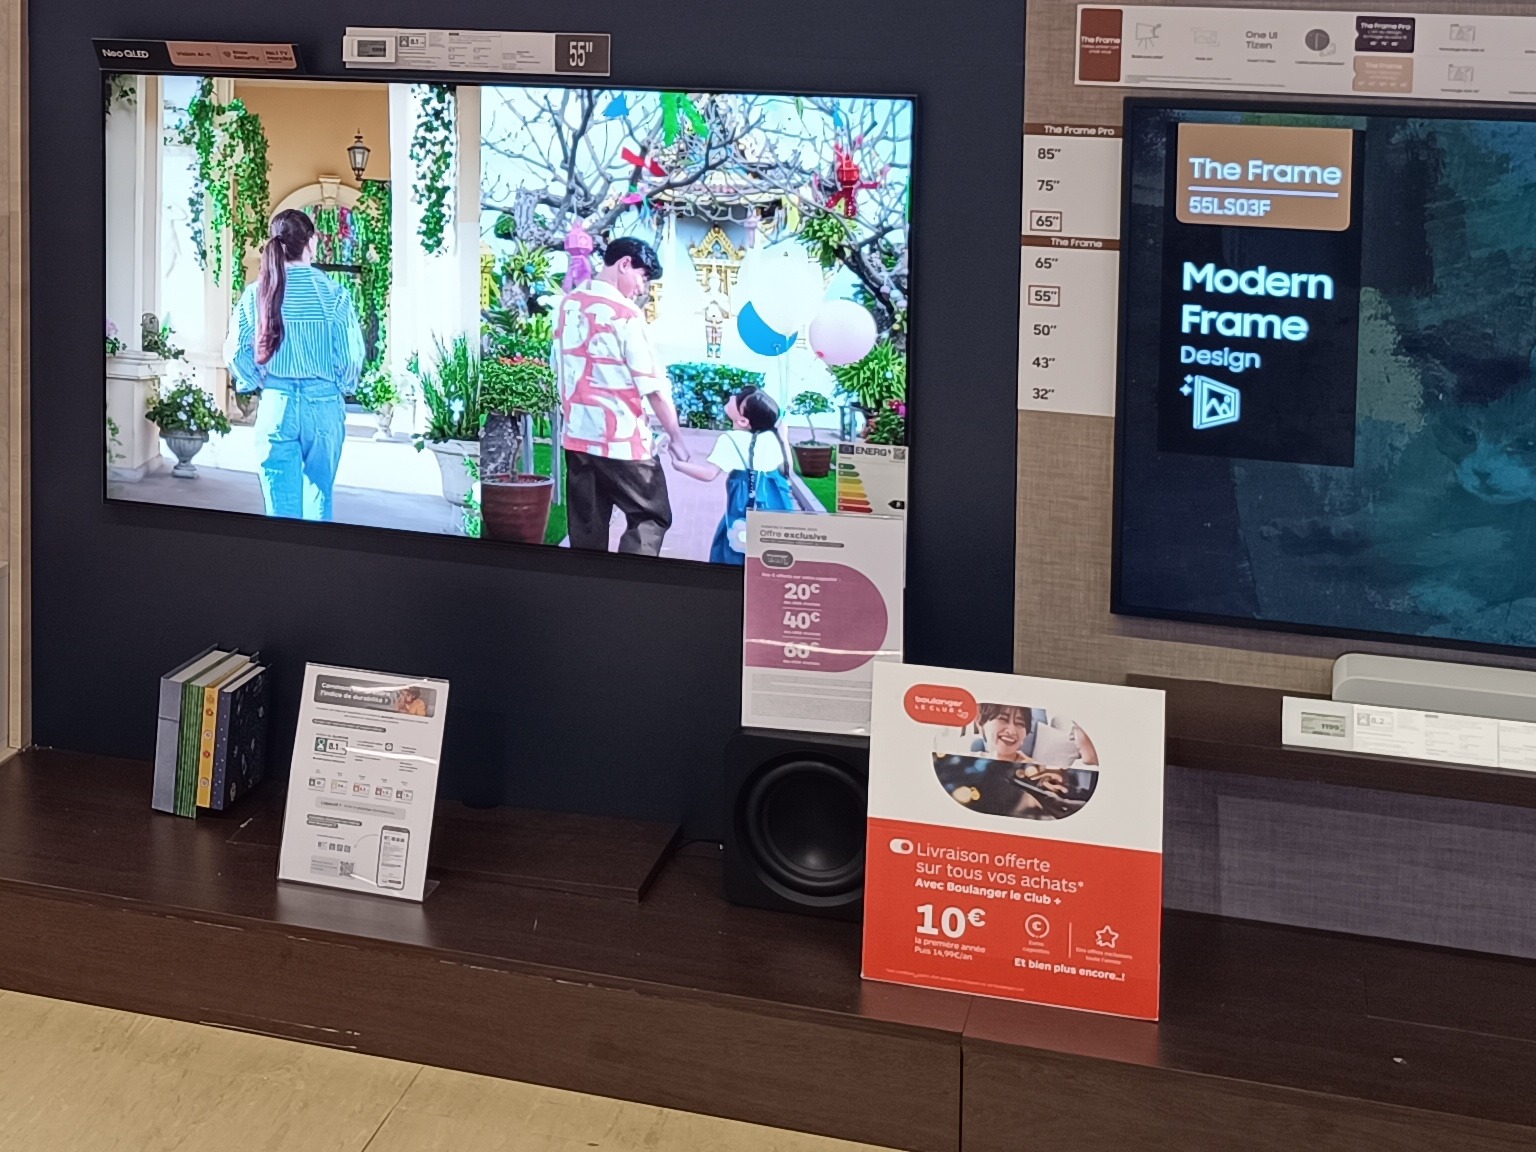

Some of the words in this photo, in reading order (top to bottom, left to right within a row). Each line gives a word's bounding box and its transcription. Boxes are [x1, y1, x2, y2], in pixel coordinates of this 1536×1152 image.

[1081, 36, 1095, 44] The
[1096, 36, 1120, 44] Frame
[1246, 31, 1266, 39] One
[1246, 40, 1272, 49] Tizen
[102, 49, 123, 58] Neo
[1044, 125, 1062, 134] The
[1064, 126, 1096, 135] Frame
[1098, 127, 1115, 136] Pro
[1189, 157, 1242, 181] The
[1247, 160, 1342, 185] Frame
[1189, 196, 1271, 217] 55LS03F
[1051, 238, 1069, 246] The
[1070, 238, 1103, 248] Frame
[1182, 261, 1335, 300] Modern
[1181, 304, 1309, 342] Frame
[1180, 345, 1261, 373] Design
[759, 530, 781, 538] Offre
[784, 531, 827, 541] exclusive
[915, 696, 963, 707] boulanger
[917, 842, 989, 865] Livraison
[994, 854, 1050, 873] offerte
[916, 863, 941, 875] sur
[947, 864, 982, 881] tous
[987, 871, 1016, 885] vos
[915, 878, 944, 891] Avec
[947, 882, 1008, 900] Boulanger
[1010, 890, 1021, 901] le
[1024, 892, 1051, 905] Club
[916, 904, 986, 939] 10€
[924, 939, 959, 950] première
[1014, 957, 1025, 968] Et
[1029, 959, 1052, 972] bien
[1053, 964, 1076, 977] plus
